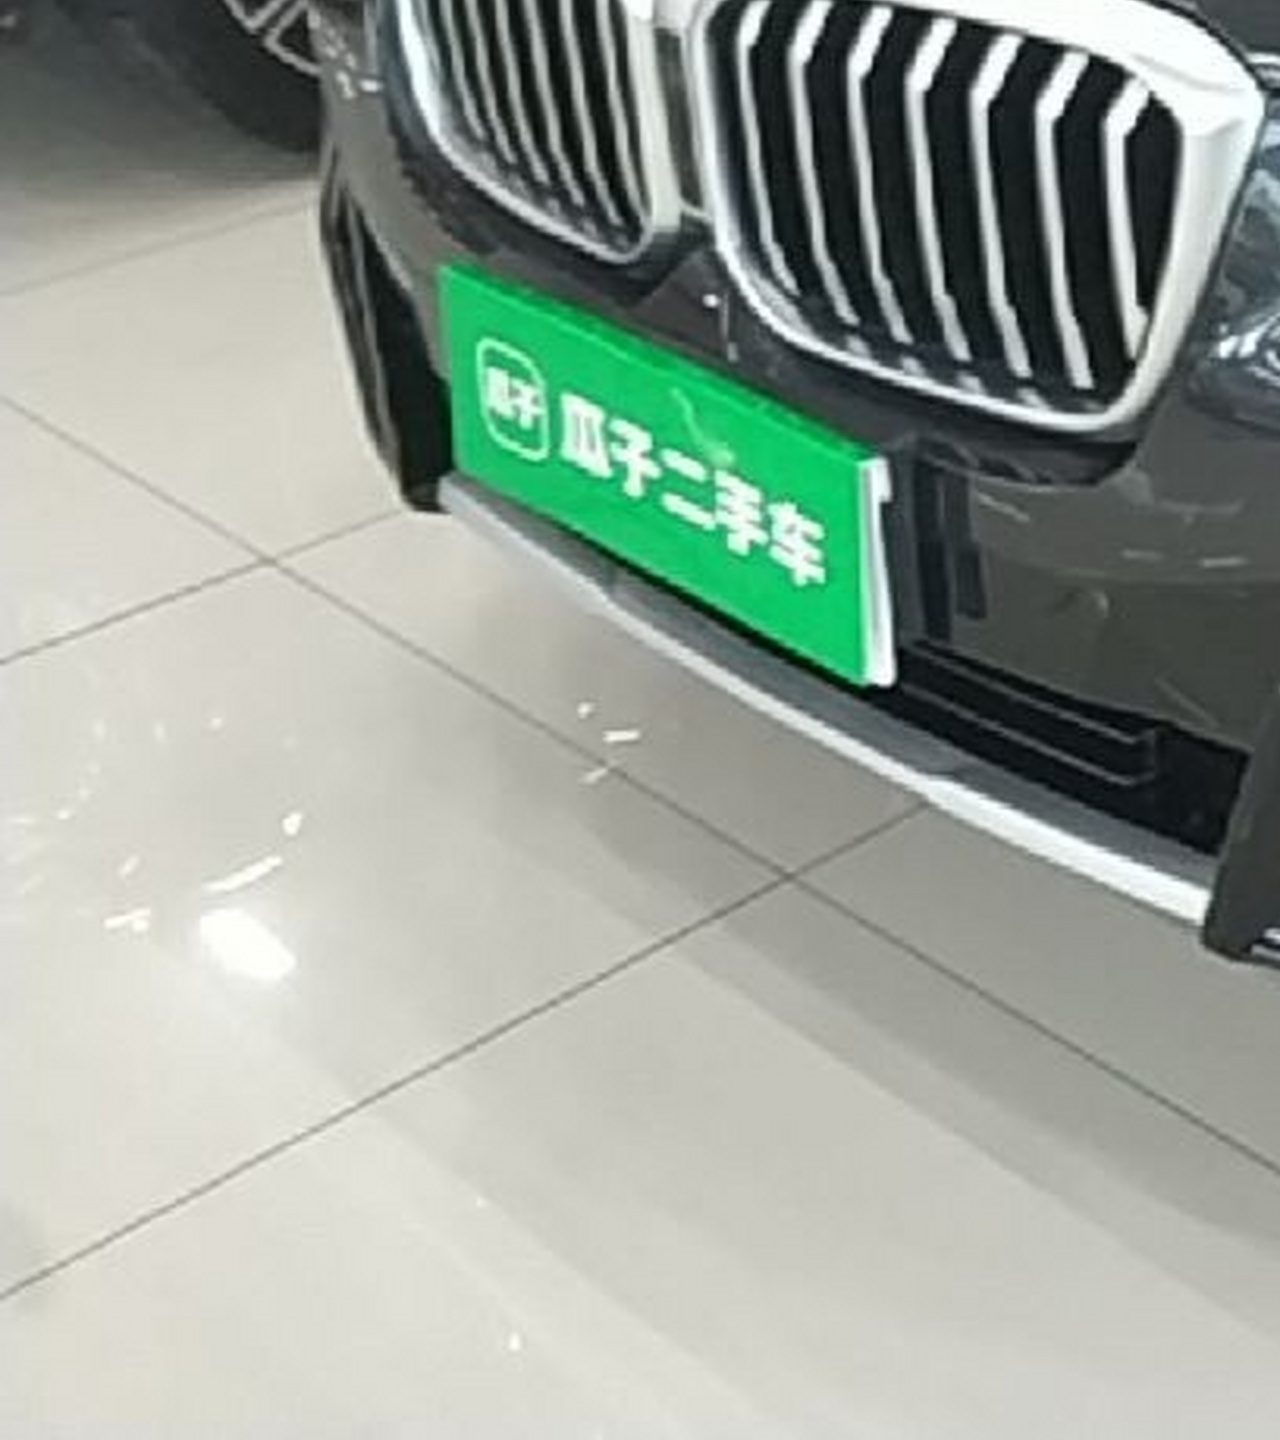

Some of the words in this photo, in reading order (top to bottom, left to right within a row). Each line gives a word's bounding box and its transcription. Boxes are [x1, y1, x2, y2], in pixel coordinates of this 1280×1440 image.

[560, 391, 827, 586] 瓜子二手车
